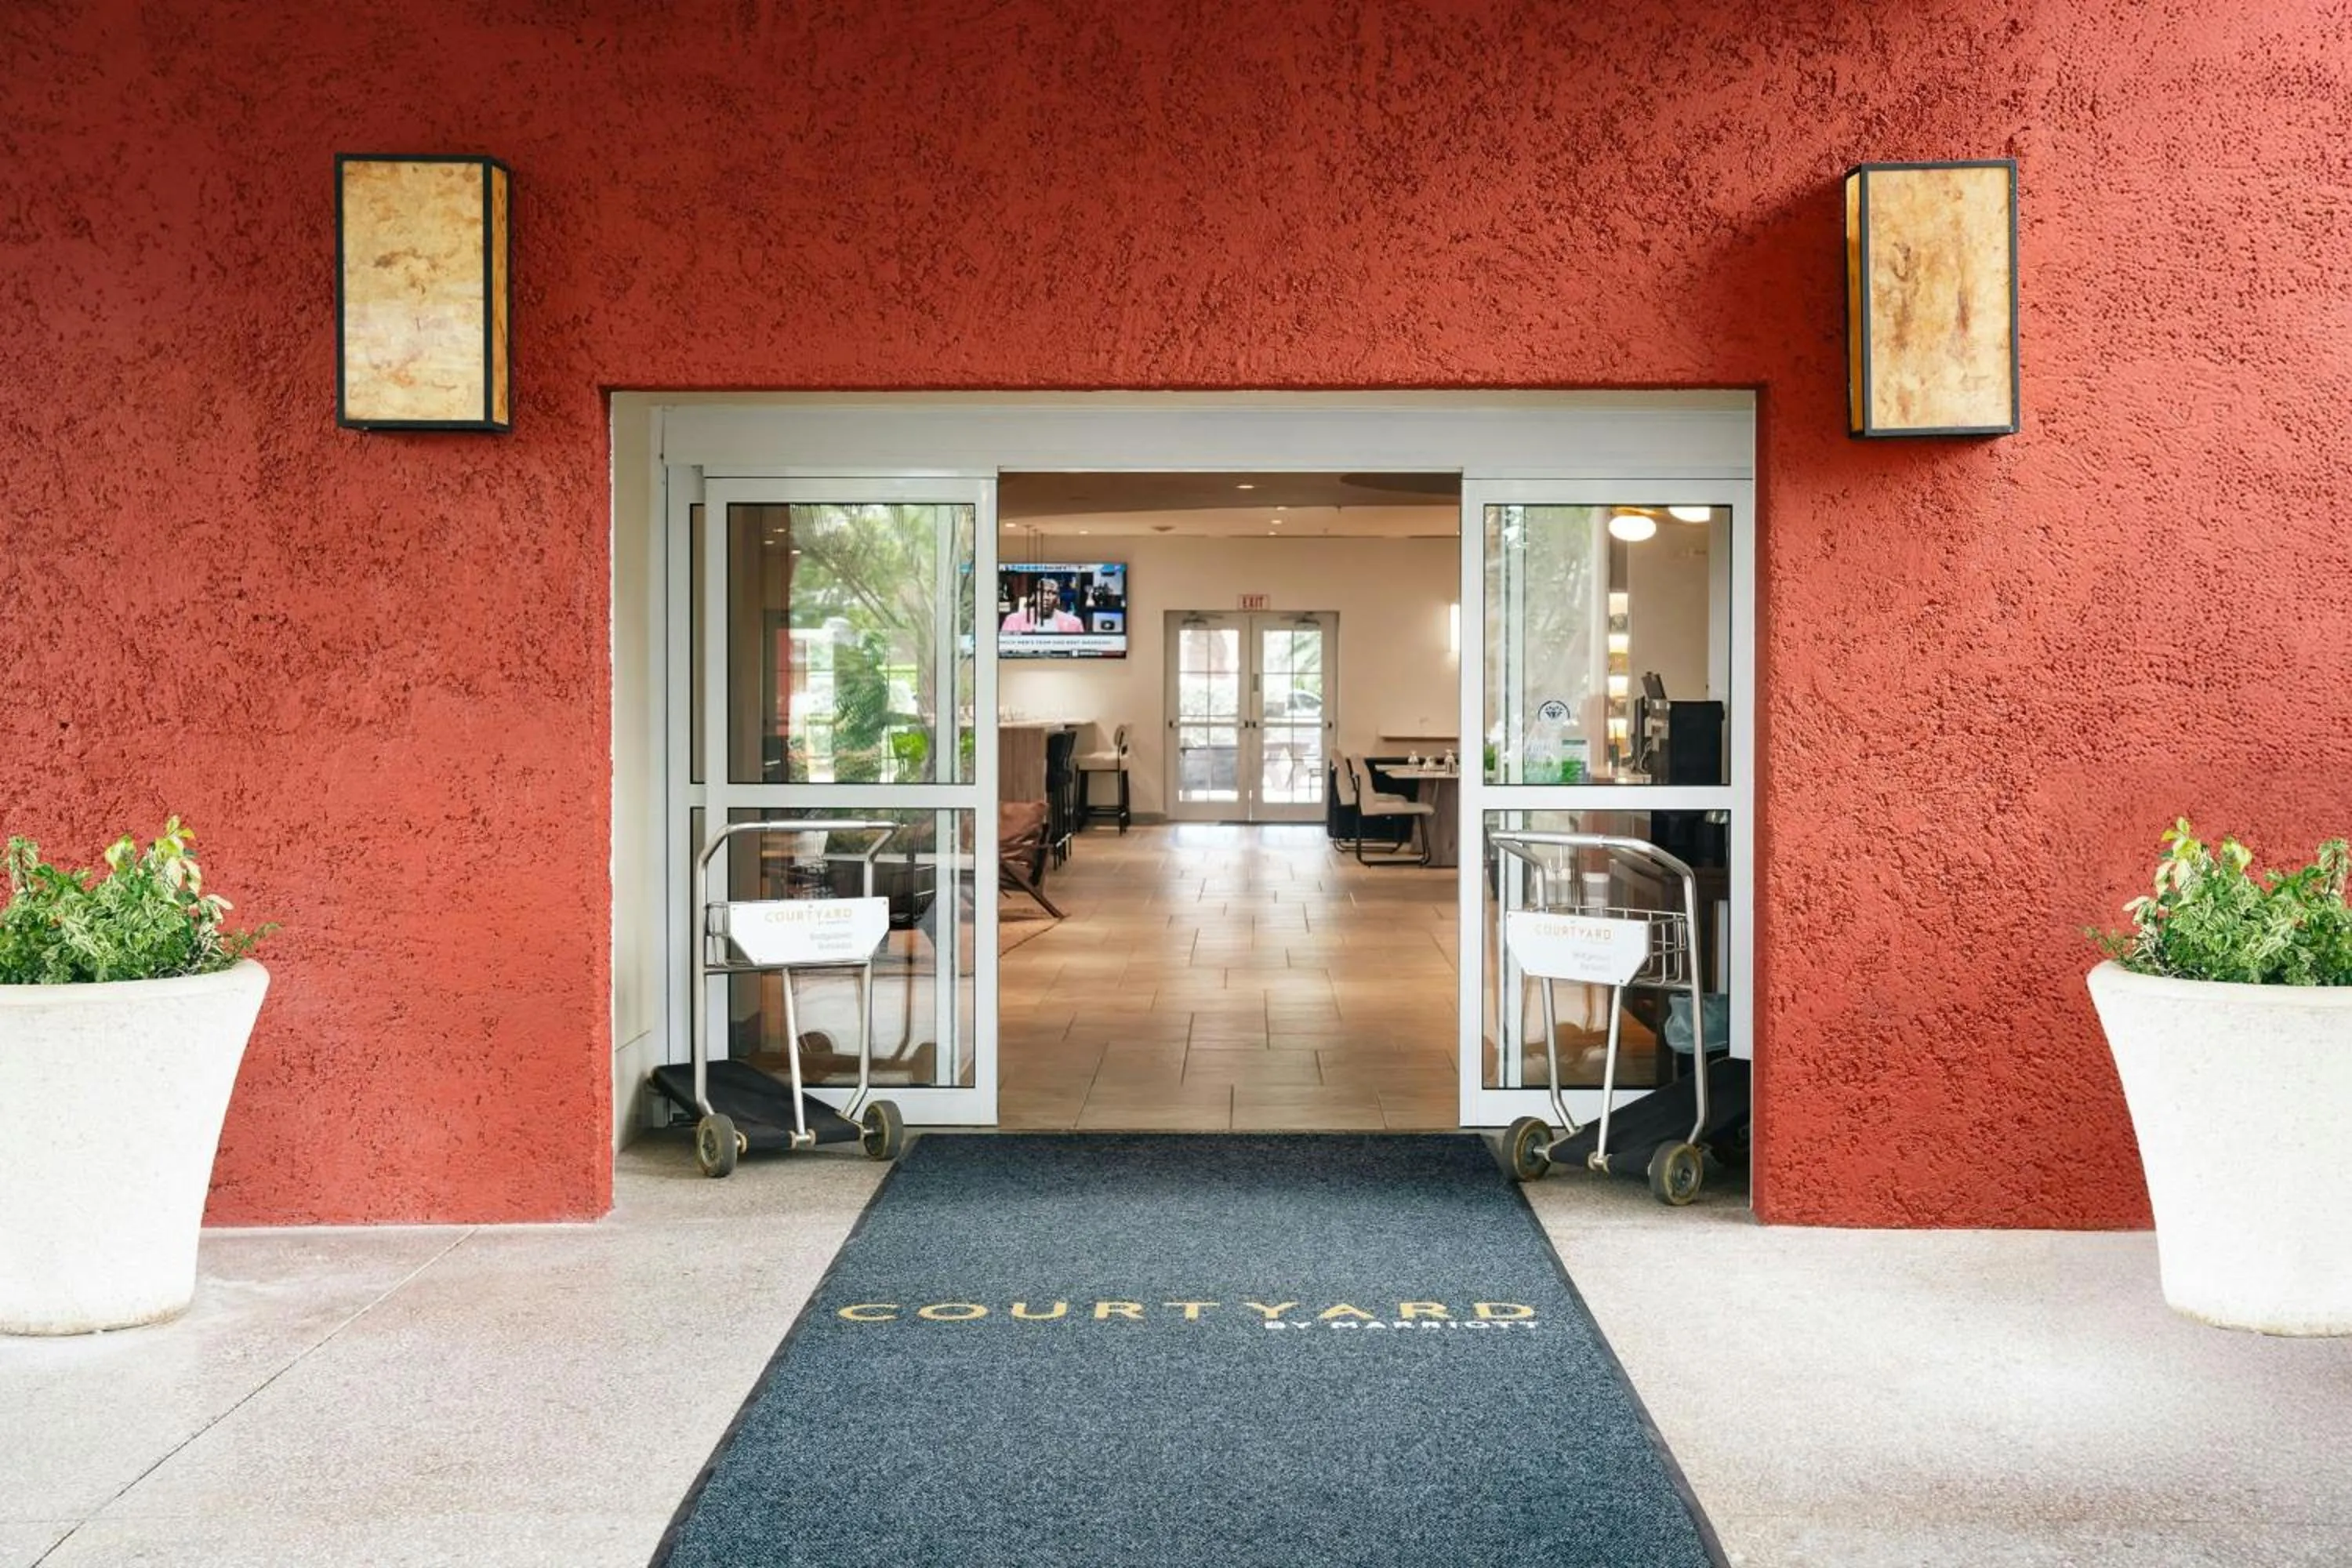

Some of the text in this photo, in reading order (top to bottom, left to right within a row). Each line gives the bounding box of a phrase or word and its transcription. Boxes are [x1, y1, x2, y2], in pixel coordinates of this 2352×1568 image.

[1243, 597, 1264, 608] EXIT
[764, 908, 853, 923] COURTYARD
[1534, 923, 1611, 939] COURTYARD
[839, 1301, 1535, 1321] COURTYARD
[1265, 1320, 1538, 1330] BY MARRIOTT
